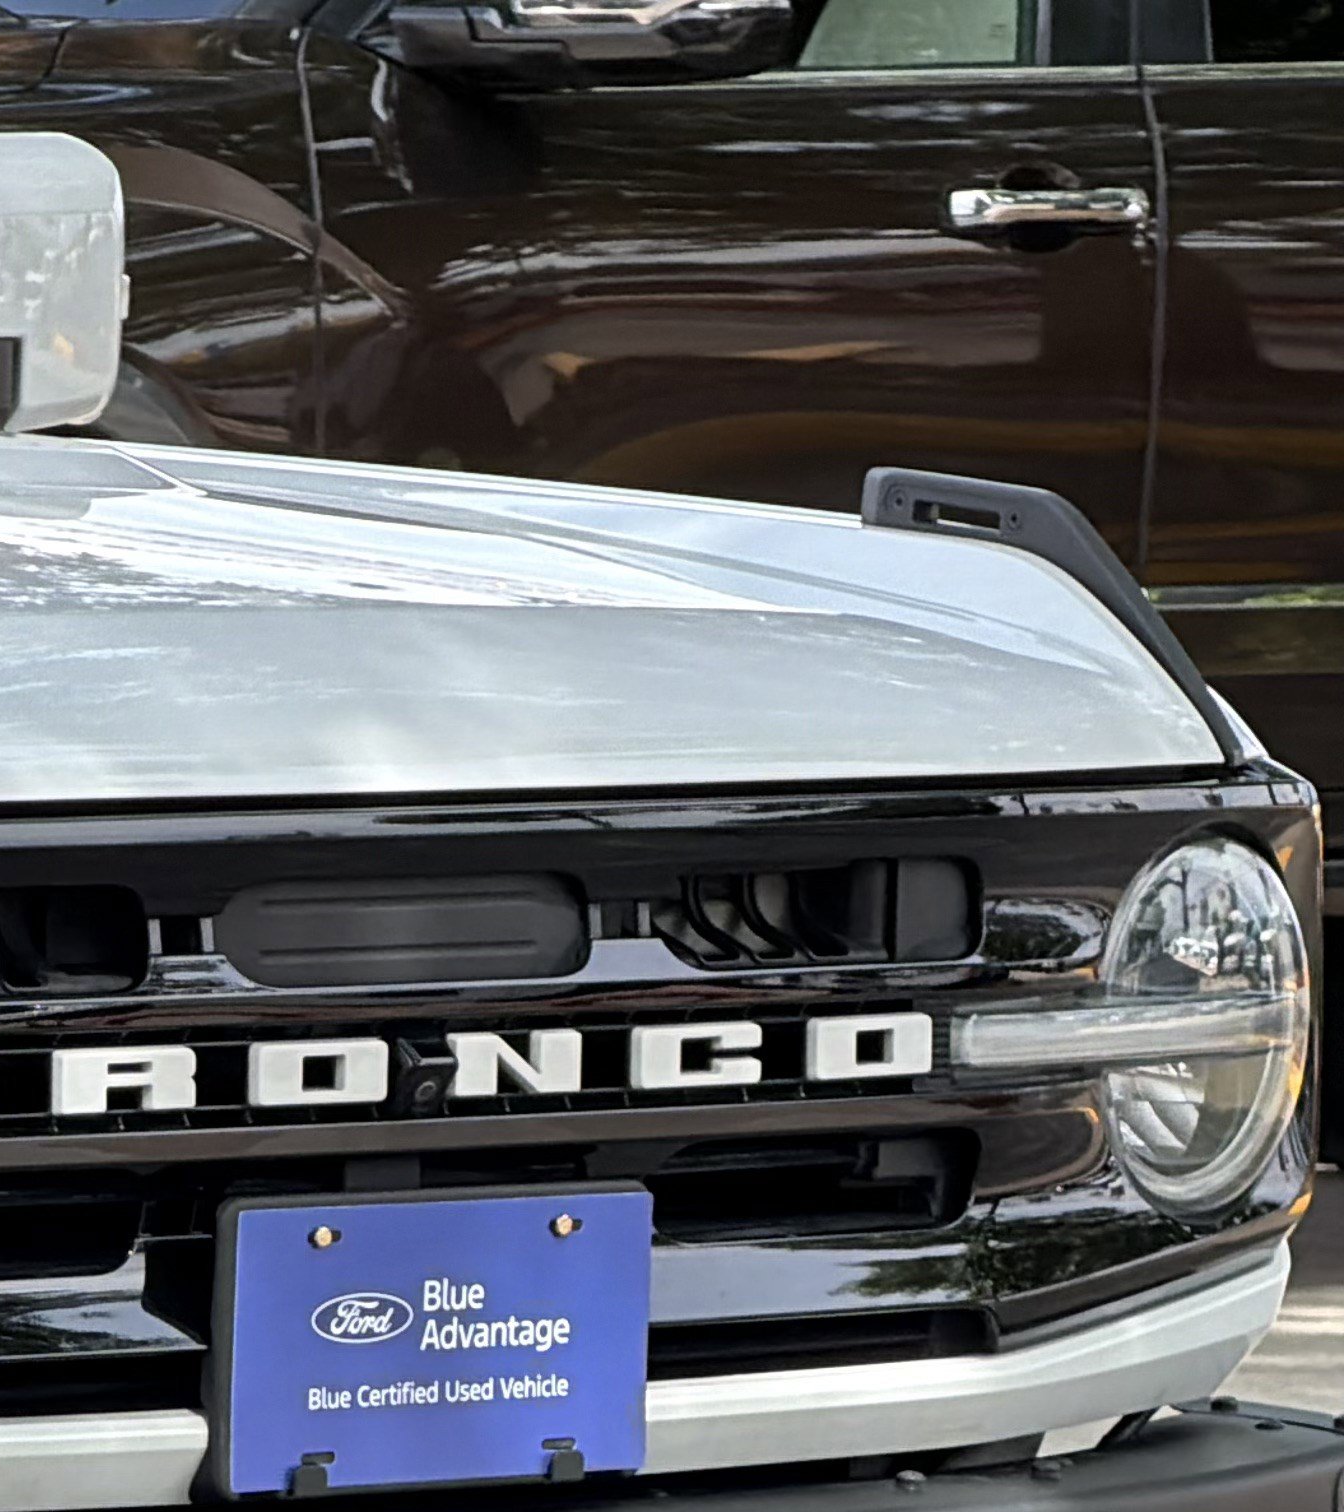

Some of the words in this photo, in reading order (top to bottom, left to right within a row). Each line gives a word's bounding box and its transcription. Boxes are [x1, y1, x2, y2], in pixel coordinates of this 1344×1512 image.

[422, 1278, 485, 1311] Blue
[330, 1299, 395, 1336] Ford
[420, 1316, 570, 1352] Advantage
[308, 1386, 352, 1410] Blue
[357, 1380, 439, 1408] Certified
[445, 1377, 494, 1403] Used
[501, 1374, 569, 1399] Vehicle
